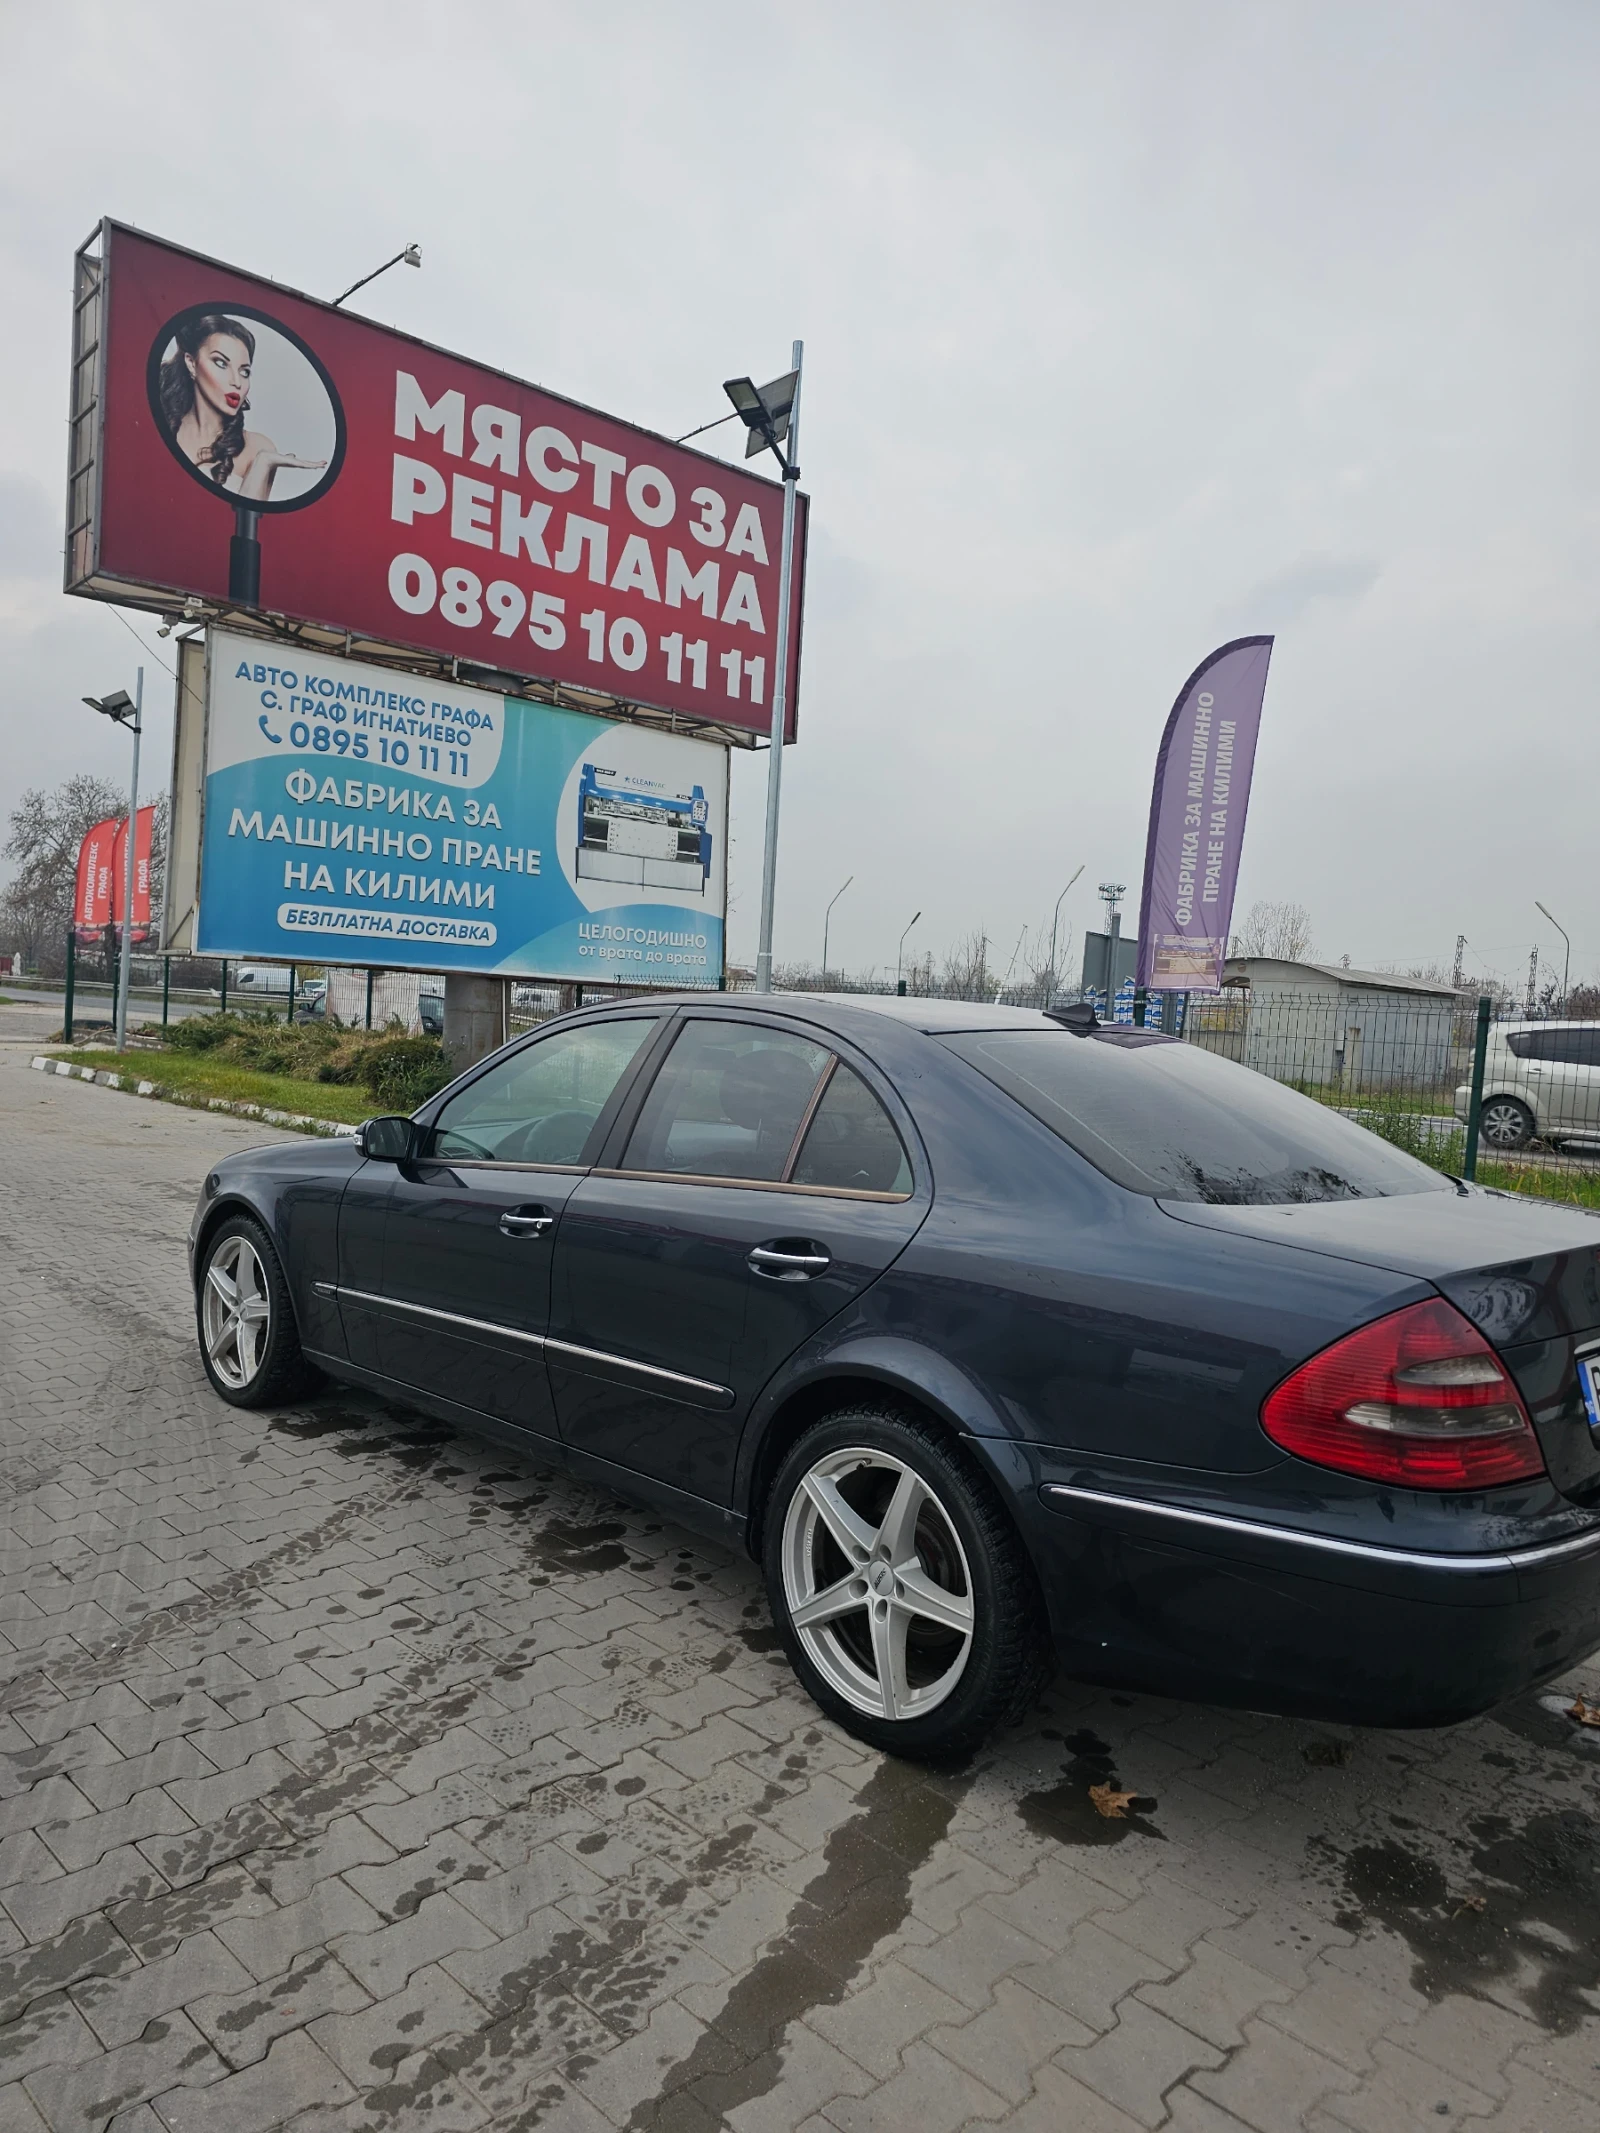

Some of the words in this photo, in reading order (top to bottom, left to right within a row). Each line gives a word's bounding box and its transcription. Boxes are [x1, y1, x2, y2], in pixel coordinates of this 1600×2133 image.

[394, 369, 676, 527] МЯСТО
[688, 486, 769, 566] ЗА
[391, 452, 766, 634] РЕКЛАМА
[388, 552, 566, 651] 0895
[580, 608, 647, 672] 10
[659, 631, 707, 690] 11
[720, 648, 765, 705] 11
[235, 661, 298, 690] АВТО
[304, 674, 426, 716] КОМПЛЕКС
[431, 702, 494, 731] ГРАФА
[260, 690, 283, 711] С.
[290, 695, 347, 724] ГРАФ
[353, 708, 472, 747] ИГНАТИЕВО
[289, 721, 369, 759] 0895
[378, 737, 410, 766] 10
[418, 745, 439, 772] 11
[449, 750, 468, 777] 11
[1187, 691, 1215, 800] МАШИННО
[1211, 720, 1237, 807] КИЛИМИ
[285, 768, 456, 824] ФАБРИКА
[462, 798, 502, 830] ЗА
[1184, 802, 1202, 828] ЗА
[1210, 809, 1228, 837] НА
[227, 808, 433, 861] МАШИННО
[442, 837, 542, 876] ПРАНЕ
[1202, 840, 1225, 903] ПРАНЕ
[84, 841, 99, 921] АВТОКОМПЛЕКС
[97, 866, 108, 899] ГРАФА
[138, 858, 148, 894] ГРАФА
[283, 860, 335, 894] НА
[344, 867, 496, 910] КИЛИМИ
[1174, 832, 1200, 927] ФАБРИКА
[285, 909, 394, 933] БЕЗПЛАТНА
[396, 919, 491, 941] ДОСТАВКА
[578, 922, 707, 949] ЦЕЛОГОДИШНО
[578, 946, 596, 957] от
[598, 946, 642, 962] врата
[645, 952, 663, 964] до
[666, 952, 707, 966] врата
